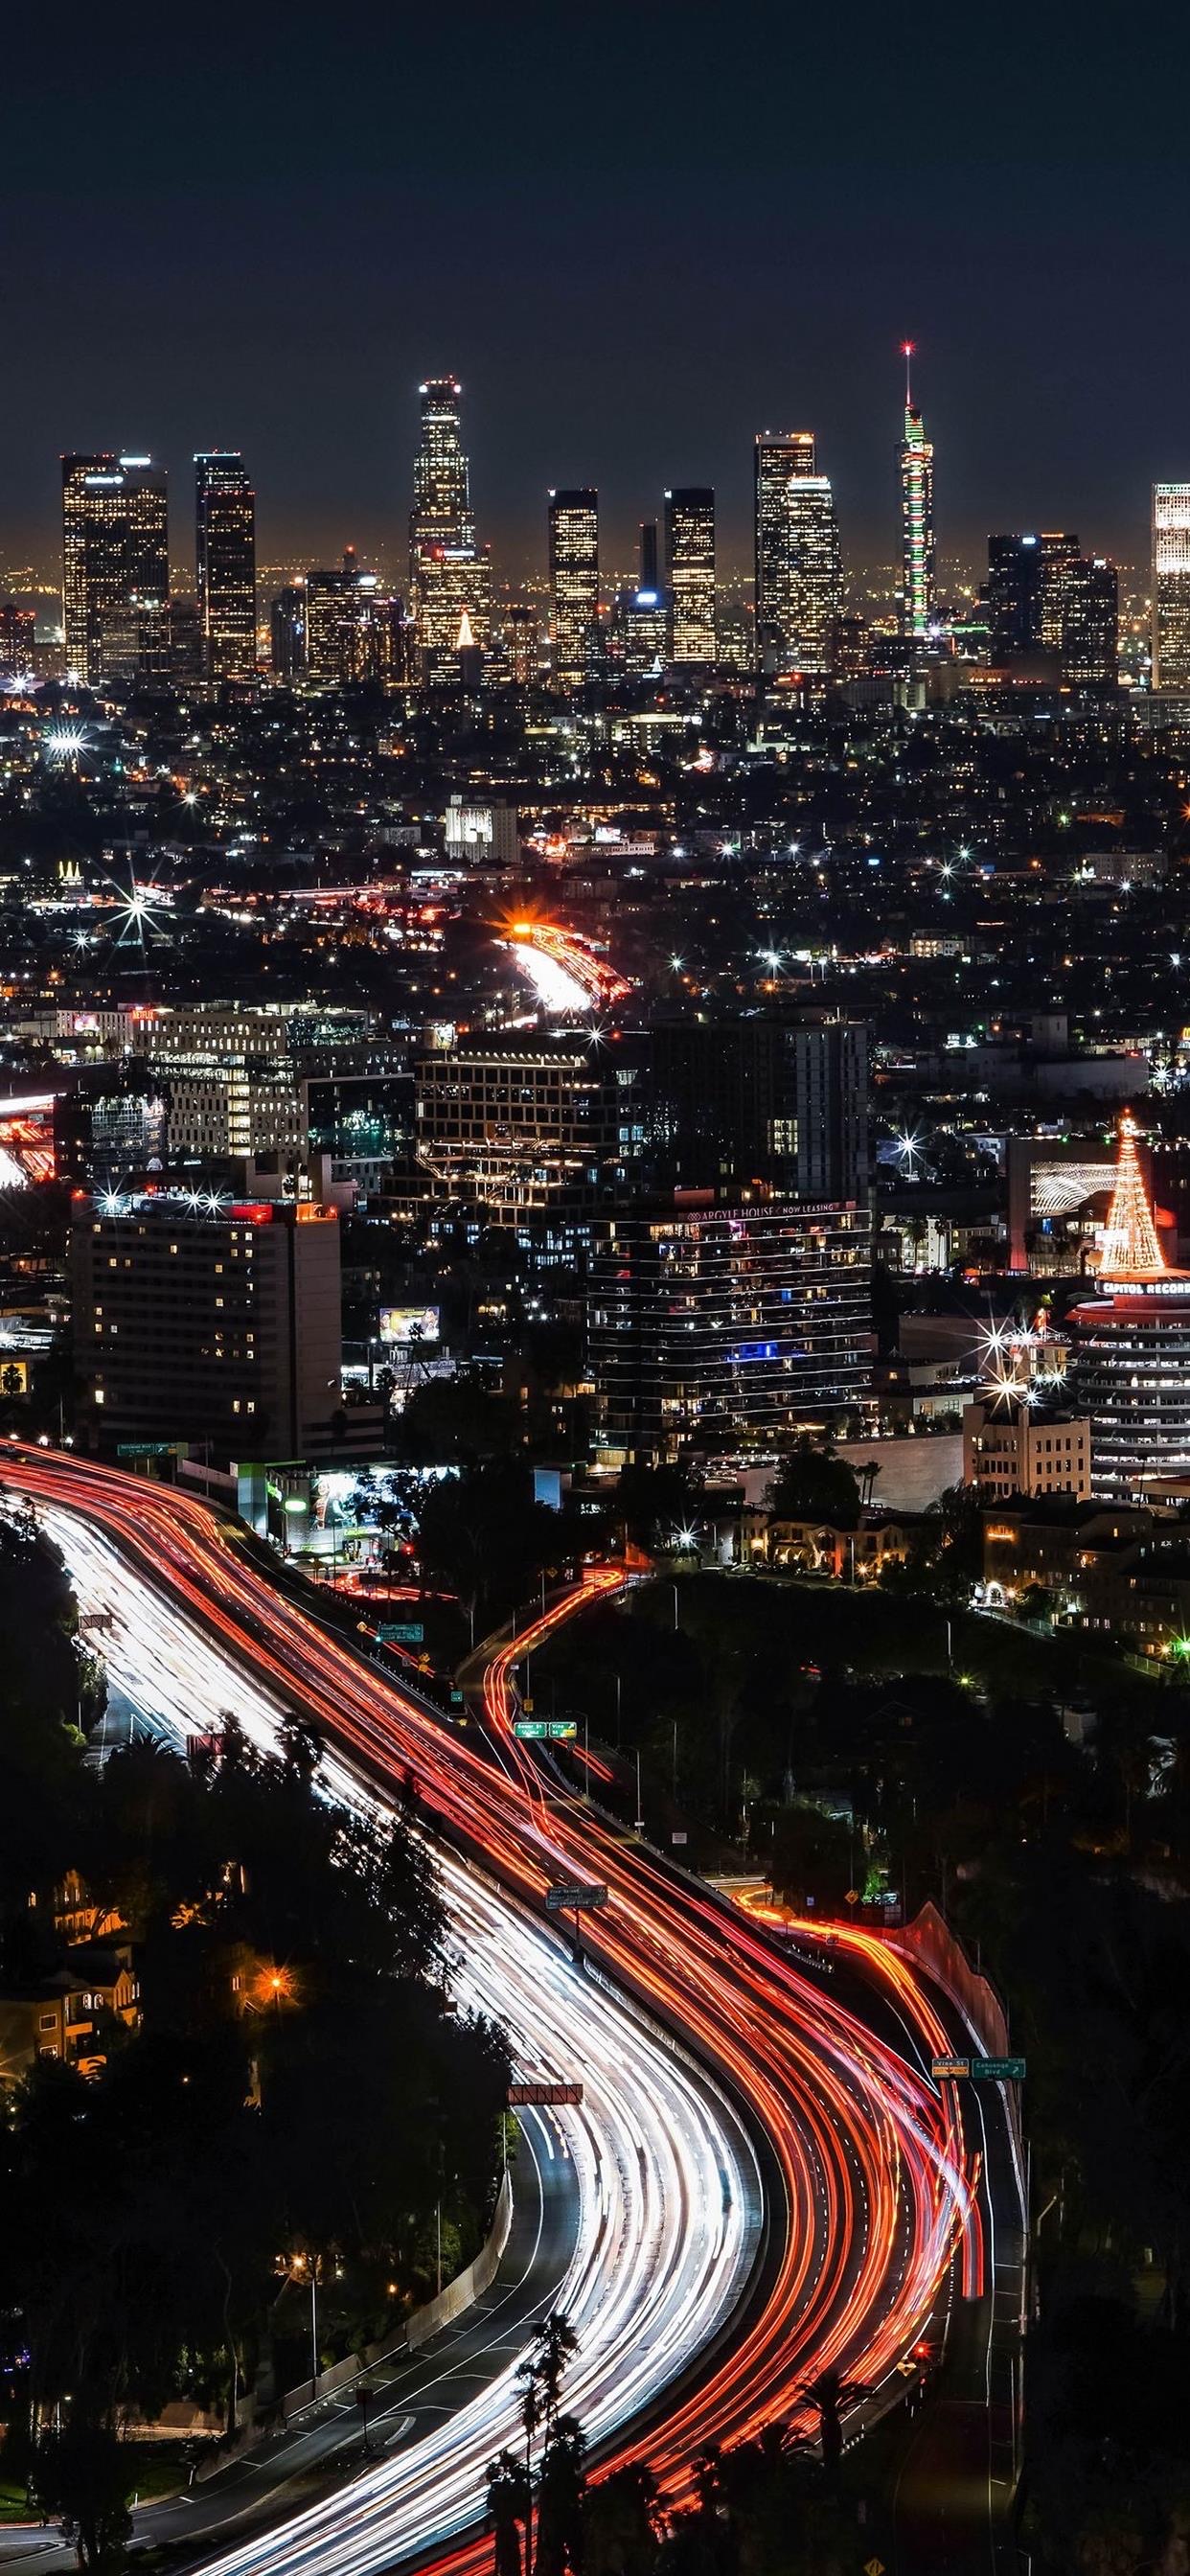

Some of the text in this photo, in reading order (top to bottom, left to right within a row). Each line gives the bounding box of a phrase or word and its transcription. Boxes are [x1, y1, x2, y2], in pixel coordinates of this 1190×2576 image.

[702, 1204, 834, 1220] ARGYLE HOUSE NOW LEASING
[1103, 1282, 1144, 1295] CAPITOL
